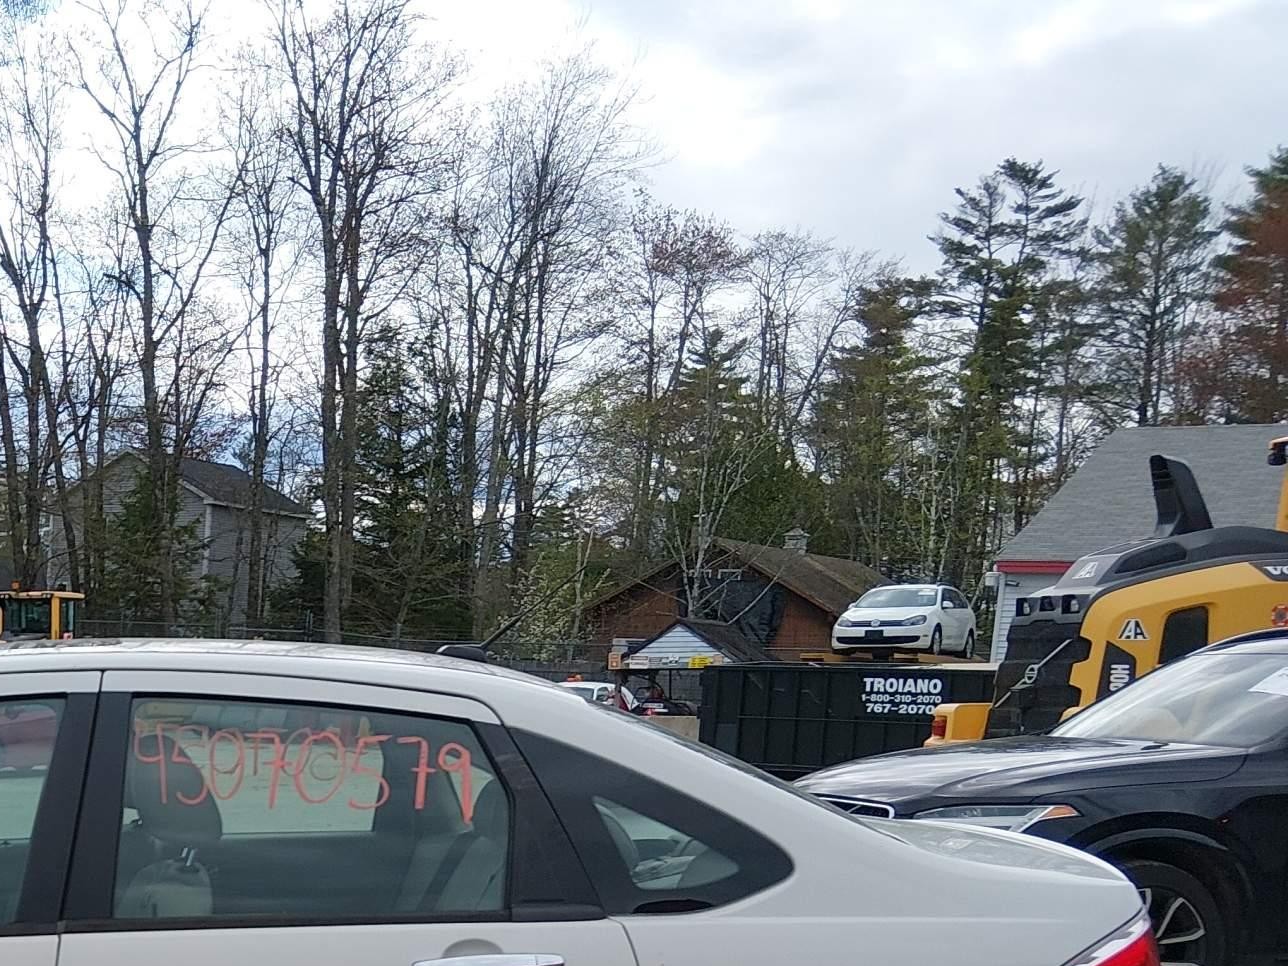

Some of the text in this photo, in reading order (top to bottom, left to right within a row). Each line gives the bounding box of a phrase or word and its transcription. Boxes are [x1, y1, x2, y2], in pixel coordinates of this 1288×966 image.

[864, 678, 942, 693] TROIANO
[862, 694, 942, 704] 1-800-310-2070
[866, 703, 936, 714] 767-2070
